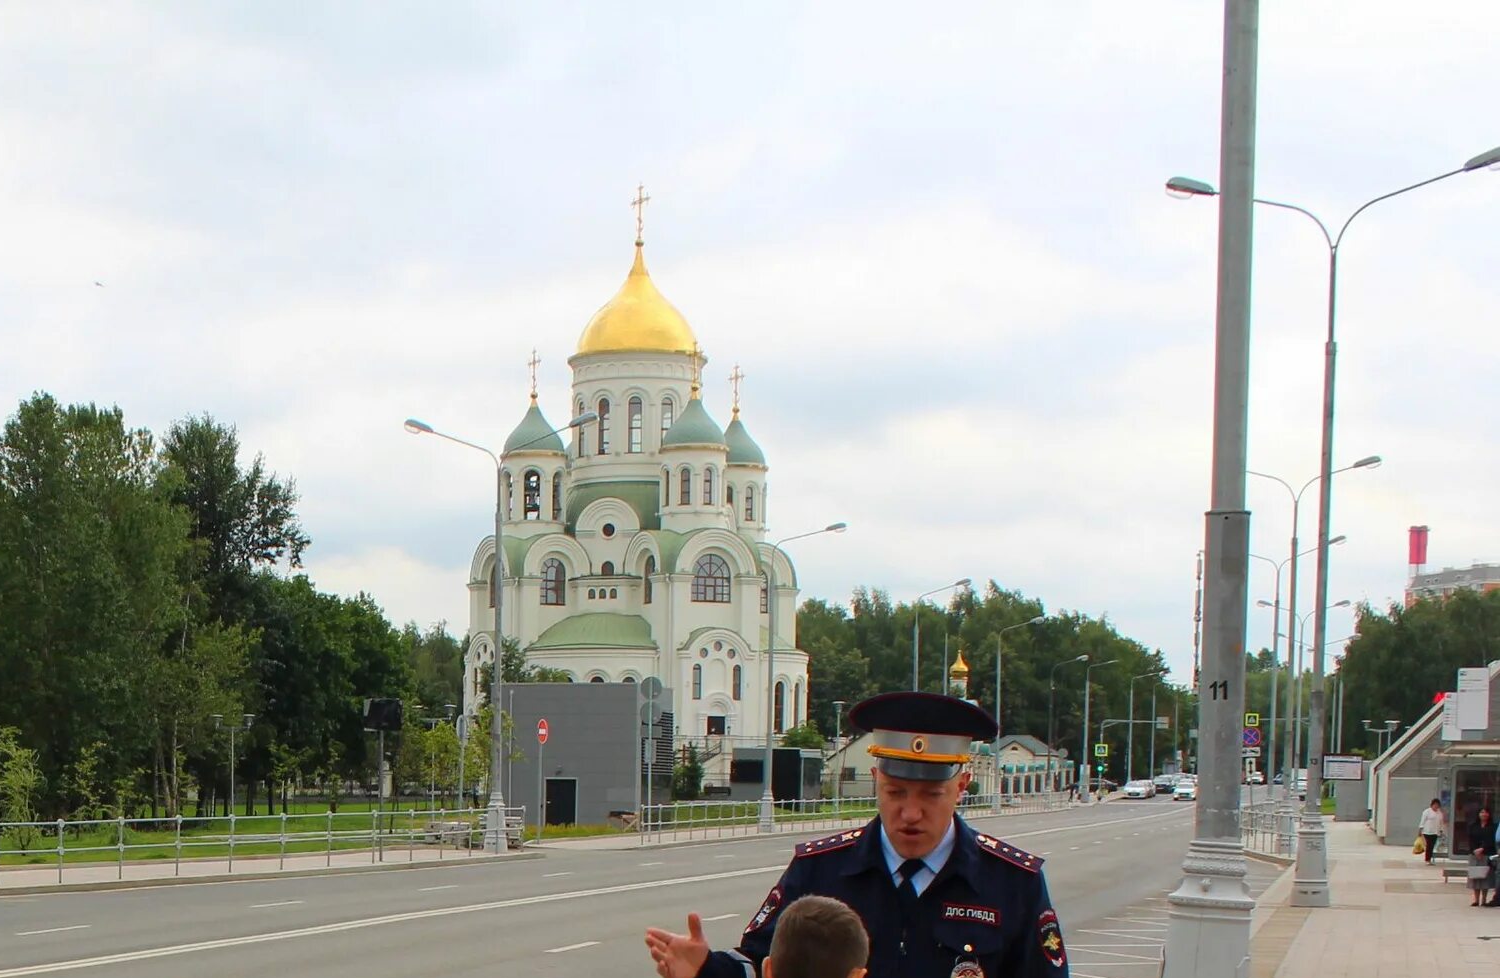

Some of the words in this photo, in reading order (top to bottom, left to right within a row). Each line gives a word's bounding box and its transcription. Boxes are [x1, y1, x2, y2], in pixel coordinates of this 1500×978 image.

[1209, 680, 1228, 700] 11
[945, 906, 965, 917] ДПС
[966, 908, 996, 923] ГИБДД
